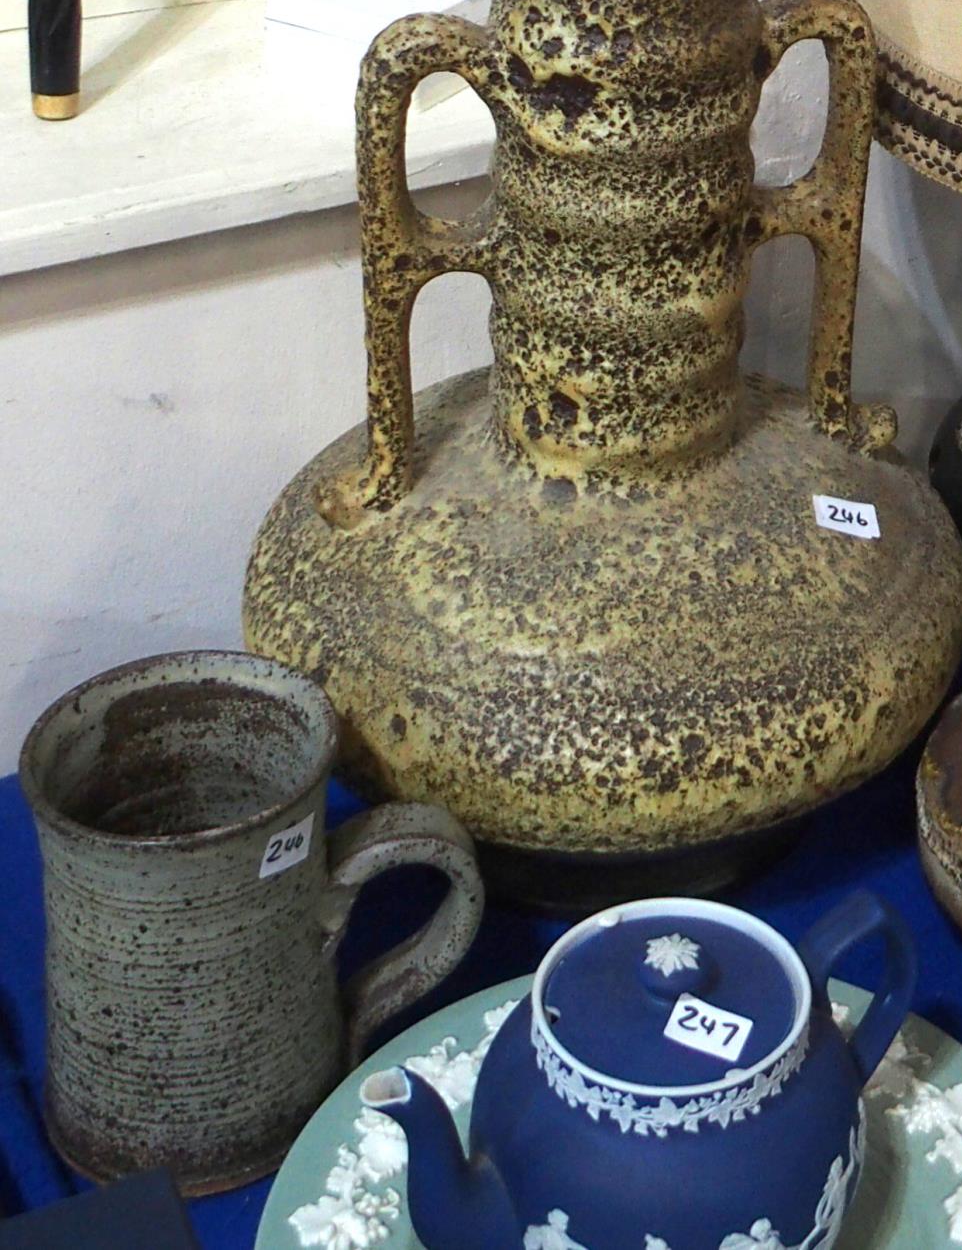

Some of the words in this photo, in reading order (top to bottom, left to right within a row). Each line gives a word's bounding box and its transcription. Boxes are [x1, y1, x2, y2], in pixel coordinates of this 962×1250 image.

[827, 504, 869, 526] 246
[266, 832, 304, 863] 246
[677, 1005, 740, 1046] 247
